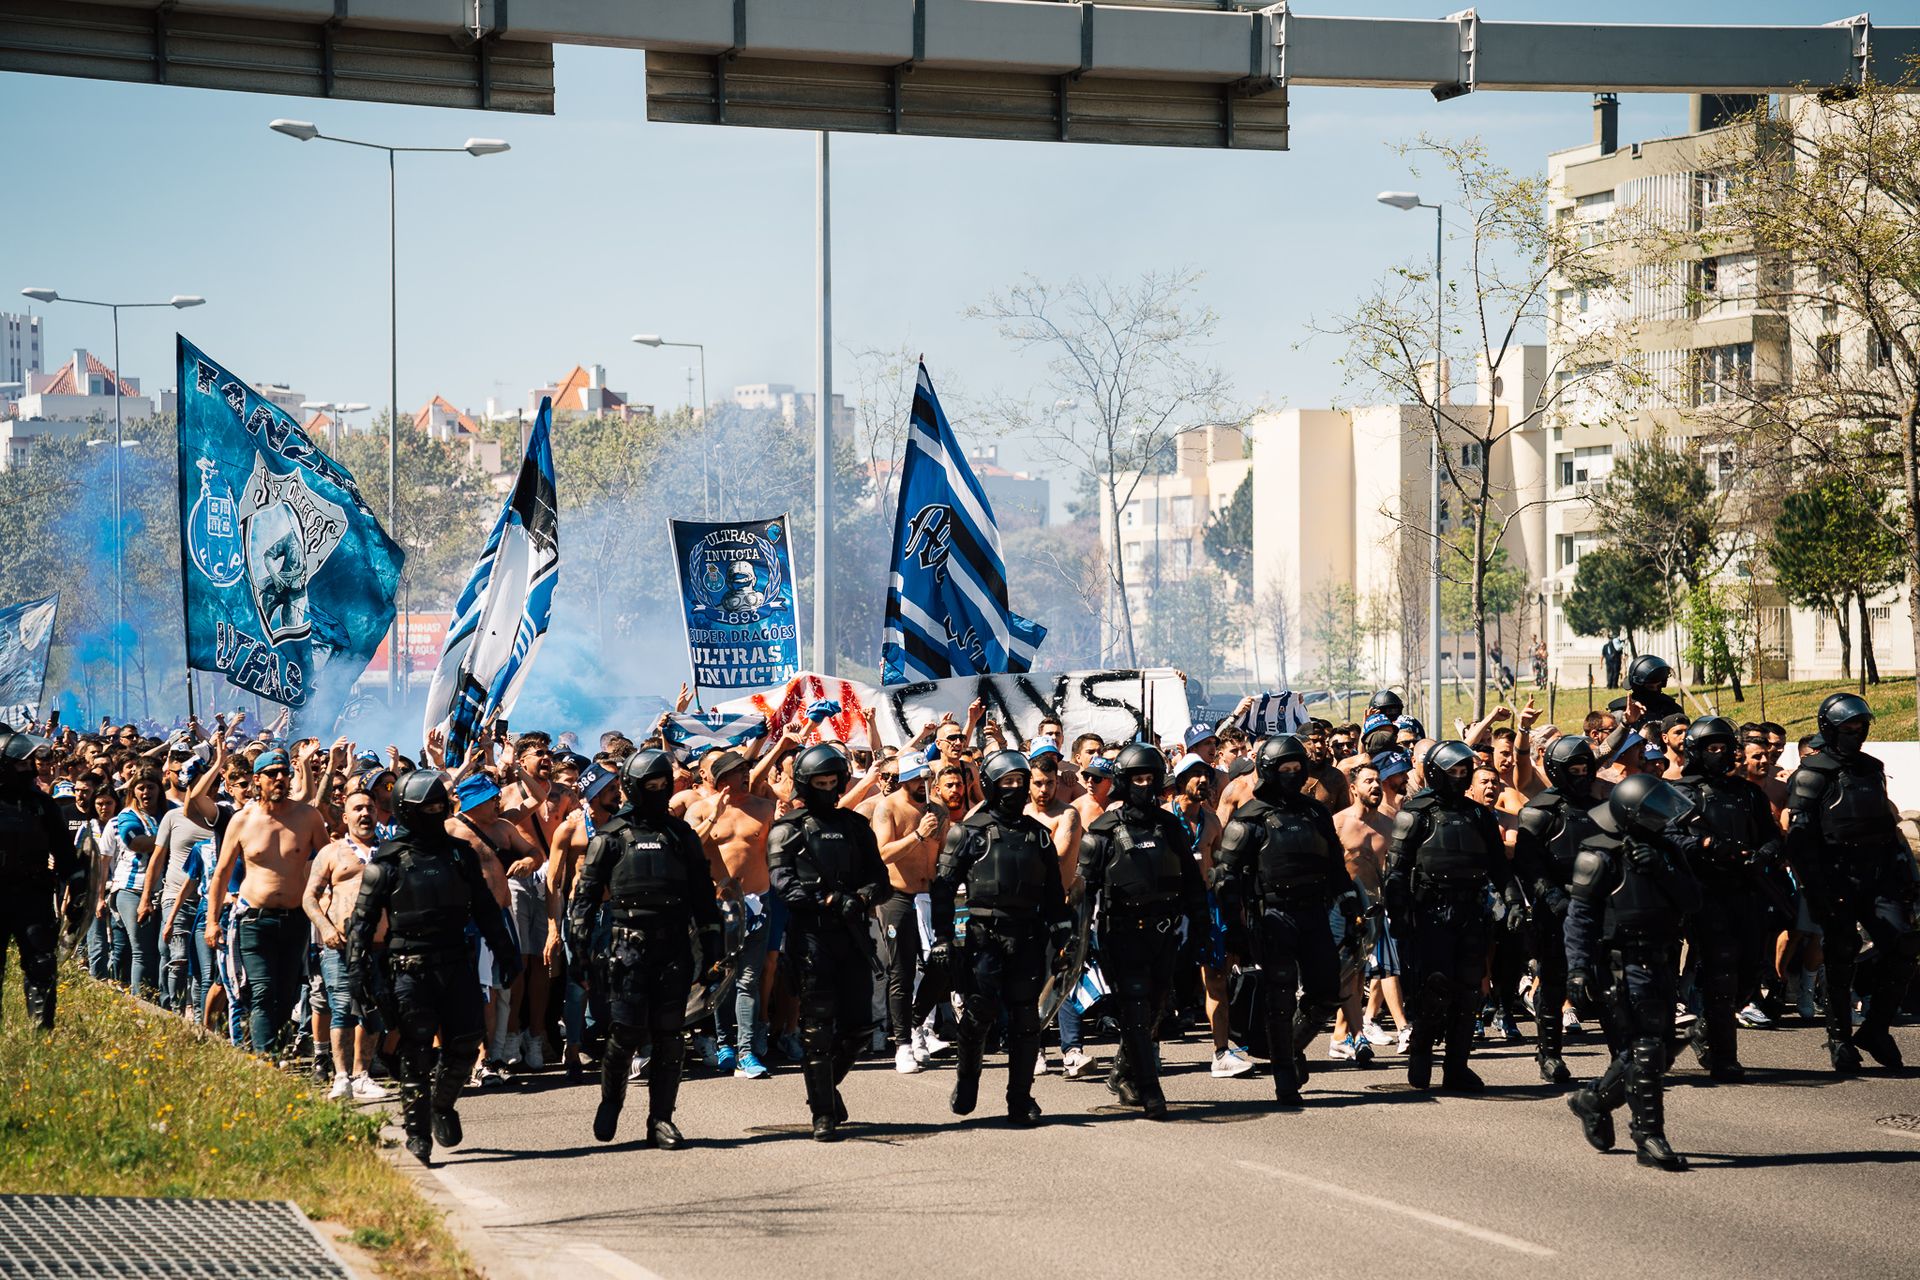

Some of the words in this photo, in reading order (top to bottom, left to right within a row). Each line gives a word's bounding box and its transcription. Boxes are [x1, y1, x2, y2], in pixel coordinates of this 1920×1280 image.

[704, 529, 757, 547] ULTRAS
[704, 548, 761, 563] INVICTA
[716, 611, 761, 625] 1893
[731, 623, 796, 643] DRAGÕES
[693, 645, 782, 666] ULTRAS
[697, 664, 797, 686] INVICTA
